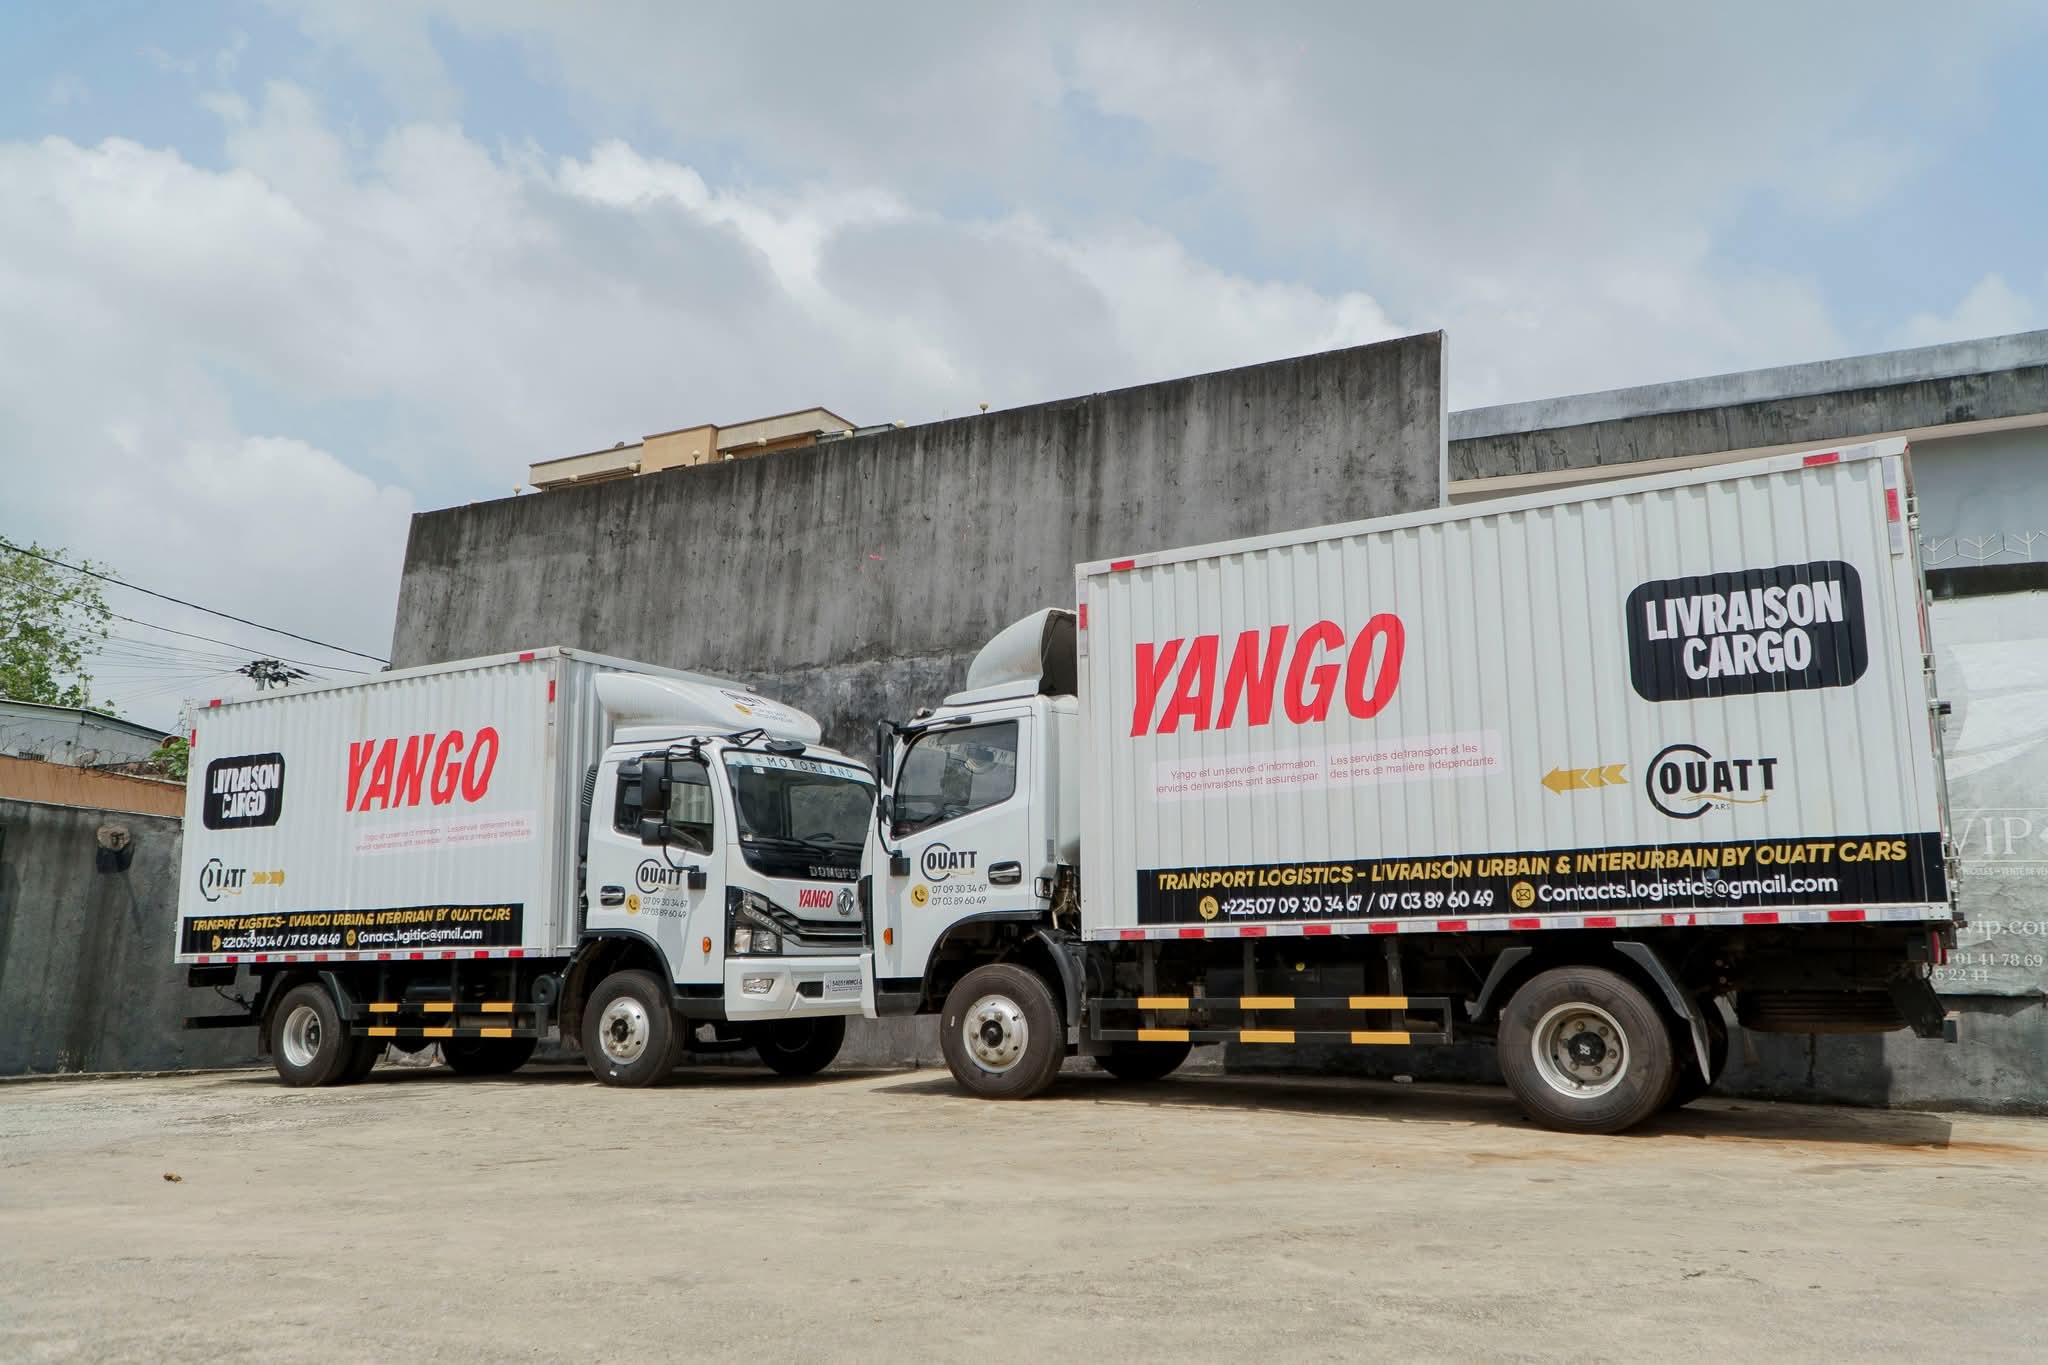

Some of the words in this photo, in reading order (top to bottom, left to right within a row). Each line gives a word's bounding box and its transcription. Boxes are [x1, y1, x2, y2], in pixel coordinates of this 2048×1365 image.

[1646, 580, 1843, 640] LIVRAISON
[1683, 627, 1812, 680] CARGO
[1130, 613, 1405, 737] YANGO
[1330, 755, 1348, 765] Les
[1462, 743, 1477, 753] les
[345, 726, 499, 813] YANGO
[767, 756, 853, 778] MOTORLAND
[1330, 768, 1348, 778] des
[213, 763, 280, 794] LIVRAISON
[809, 865, 861, 880] DONGFE
[1158, 870, 1254, 891] TRANSPORT
[1258, 865, 1353, 887] LOGISTICS
[1371, 860, 1472, 882] LIVRAISON
[1478, 856, 1550, 878] URBAIN
[1555, 854, 1571, 875] &
[1576, 848, 1718, 873] INTERURBAIN
[1722, 846, 1751, 868] BY
[1756, 843, 1835, 865] OUATT
[1839, 841, 1907, 862] CARS
[799, 888, 834, 908] YANGO
[931, 885, 941, 894] 07
[943, 885, 953, 894] 09
[955, 884, 965, 893] 30
[967, 884, 977, 893] 34
[1278, 897, 1299, 914] 09
[1302, 896, 1322, 913] 30
[1324, 895, 1344, 912] 34
[1346, 894, 1363, 912] 67
[1366, 892, 1376, 913] /
[1379, 893, 1398, 911] 07
[1400, 892, 1421, 910] 03
[1424, 891, 1444, 909] 89
[1447, 890, 1470, 908] 60
[1472, 889, 1494, 907] 49
[1538, 874, 1838, 902] Contacts.logistics@gmail.com
[931, 897, 941, 906] 07
[942, 897, 952, 906] 03
[954, 897, 963, 905] 89
[964, 896, 975, 905] 60
[2001, 953, 2020, 966] 78
[2024, 953, 2043, 967] 69
[1948, 968, 1966, 981] 22
